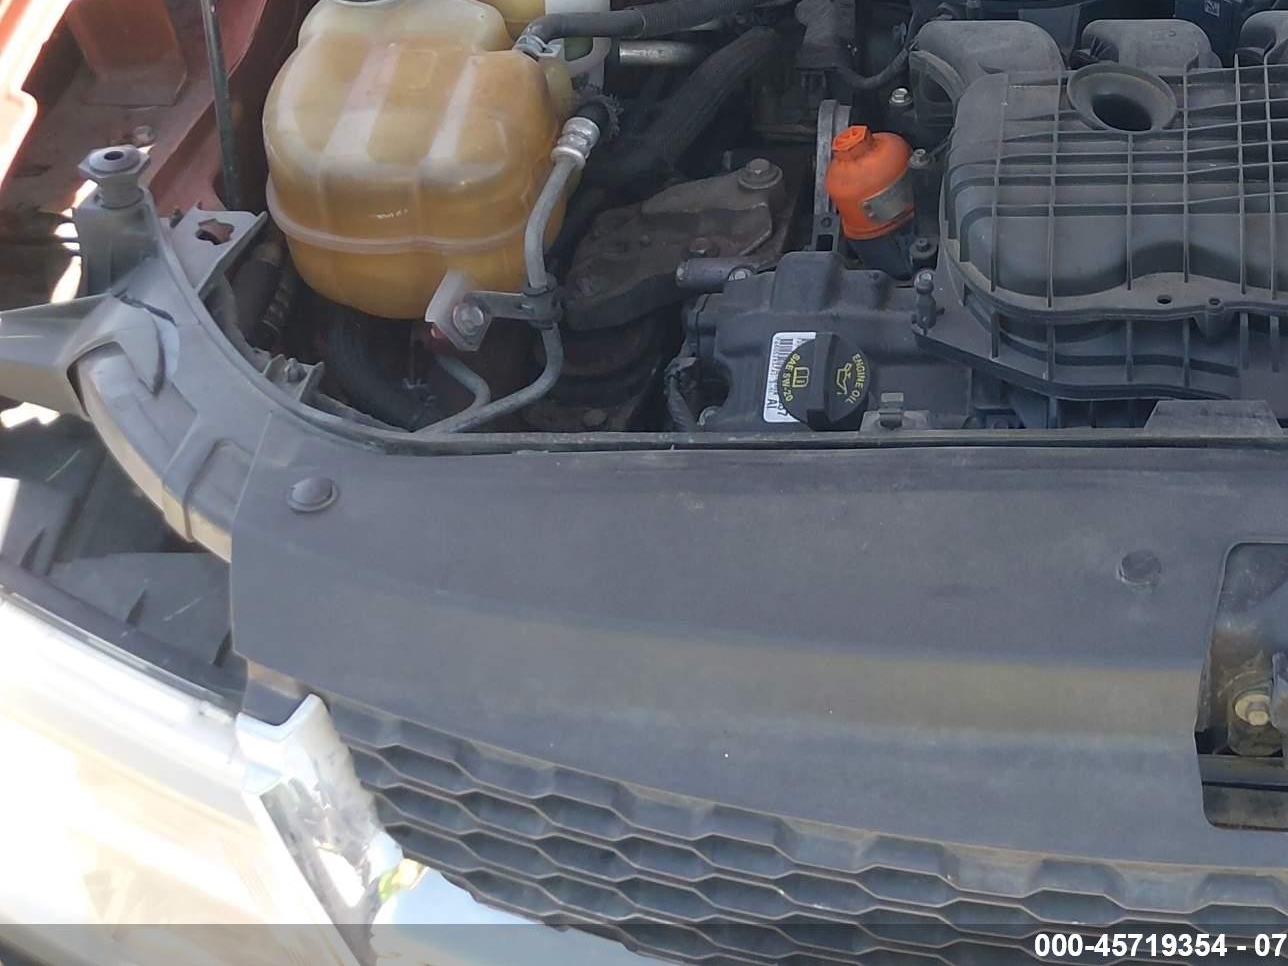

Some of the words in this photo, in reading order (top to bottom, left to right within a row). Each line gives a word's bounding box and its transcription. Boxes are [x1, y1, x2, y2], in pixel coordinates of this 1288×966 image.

[785, 353, 800, 371] SAE
[852, 354, 866, 389] ENGINE
[782, 373, 794, 402] 5W-20
[845, 389, 861, 404] OIL
